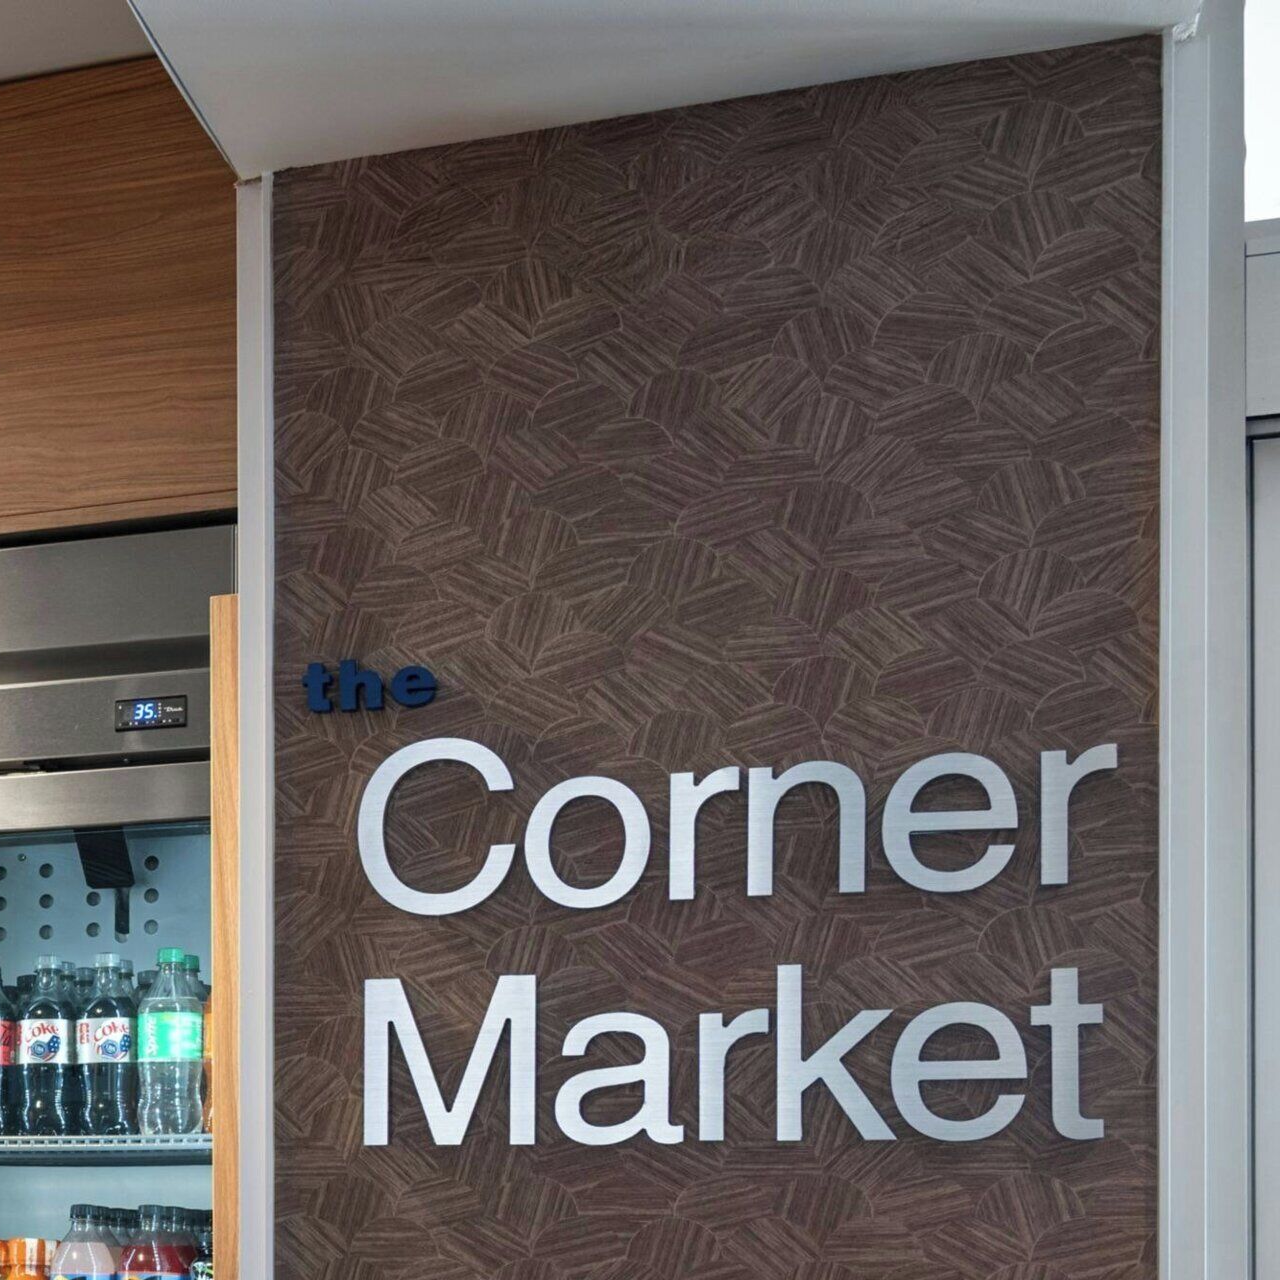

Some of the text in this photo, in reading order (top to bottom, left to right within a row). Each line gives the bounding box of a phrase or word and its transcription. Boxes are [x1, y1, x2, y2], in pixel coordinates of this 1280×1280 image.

[301, 660, 437, 715] the
[356, 736, 1118, 916] Corner
[363, 963, 1105, 1147] Market
